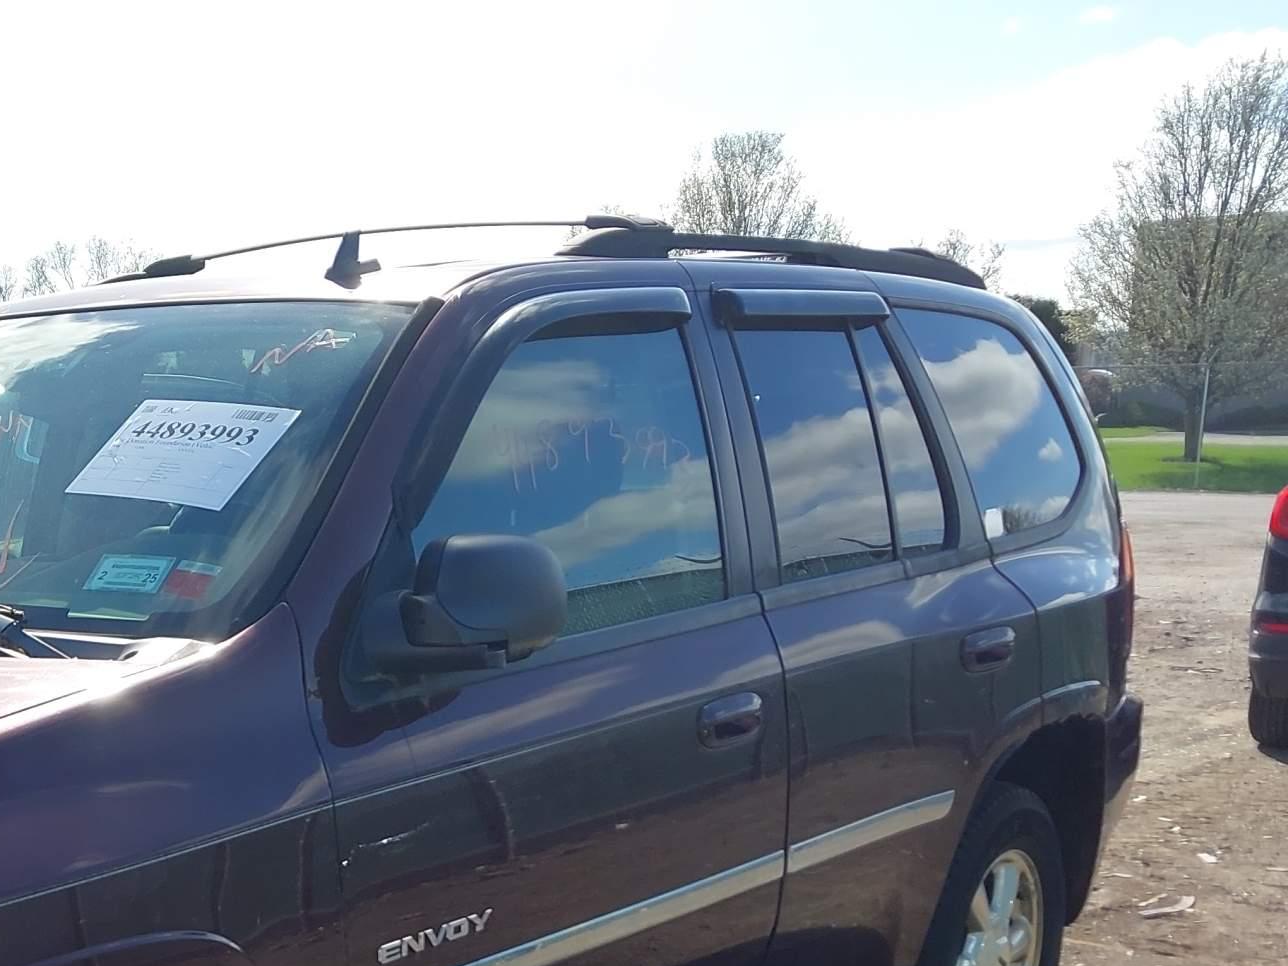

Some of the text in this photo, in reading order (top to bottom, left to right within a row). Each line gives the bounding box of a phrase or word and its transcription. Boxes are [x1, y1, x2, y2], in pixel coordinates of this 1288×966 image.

[132, 420, 259, 446] 44893993
[98, 571, 159, 583] 2 25
[378, 908, 493, 964] ENVOY
